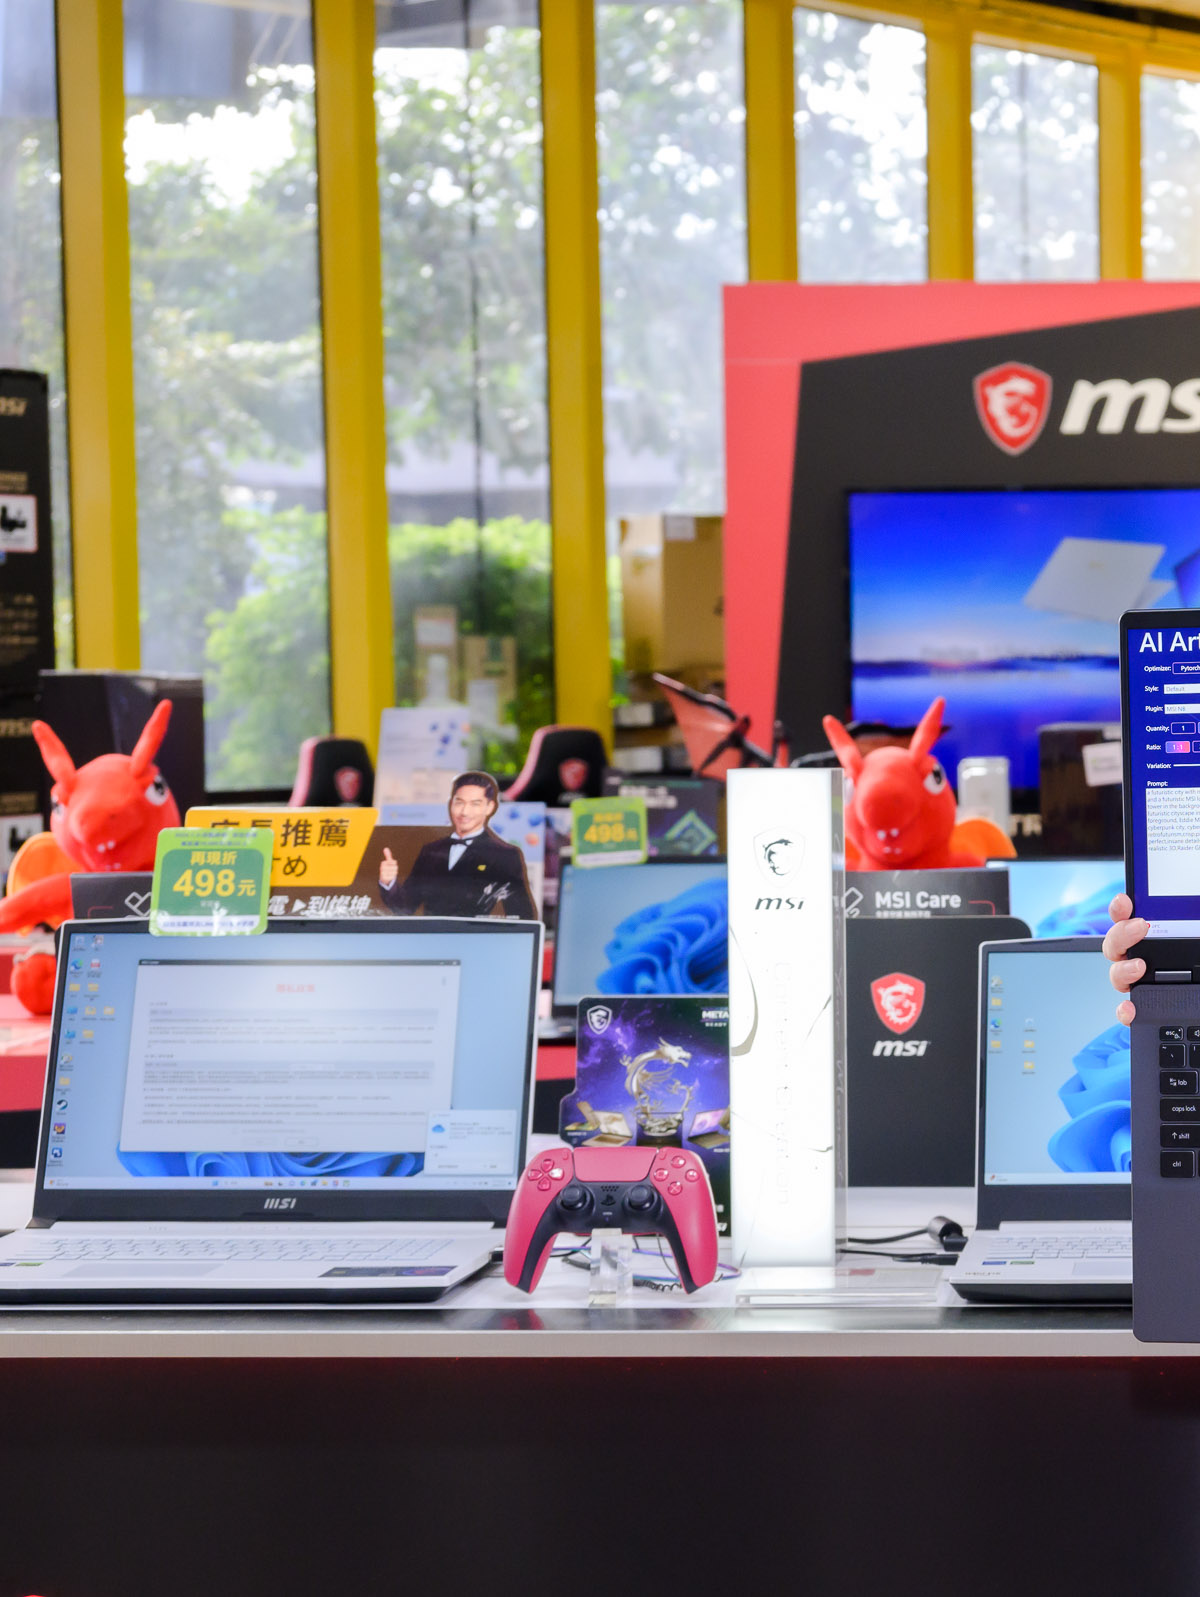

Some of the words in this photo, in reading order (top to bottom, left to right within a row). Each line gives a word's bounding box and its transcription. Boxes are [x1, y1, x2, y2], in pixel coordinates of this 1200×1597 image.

[1139, 632, 1163, 653] AI
[1144, 665, 1172, 673] Optimizer:
[1144, 685, 1159, 693] Style:
[1145, 705, 1163, 713] Plugin:
[1145, 725, 1170, 733] Quantity:
[1146, 743, 1161, 751] Ratio:
[1172, 743, 1183, 751] 1:1
[1146, 762, 1172, 770] Variation:
[1147, 780, 1169, 788] Prompt:
[189, 850, 238, 866] 再現折
[754, 896, 805, 911] msi
[875, 890, 911, 909] MSI
[915, 890, 962, 909] Care
[872, 1040, 929, 1057] msi
[1185, 1104, 1197, 1112] lock
